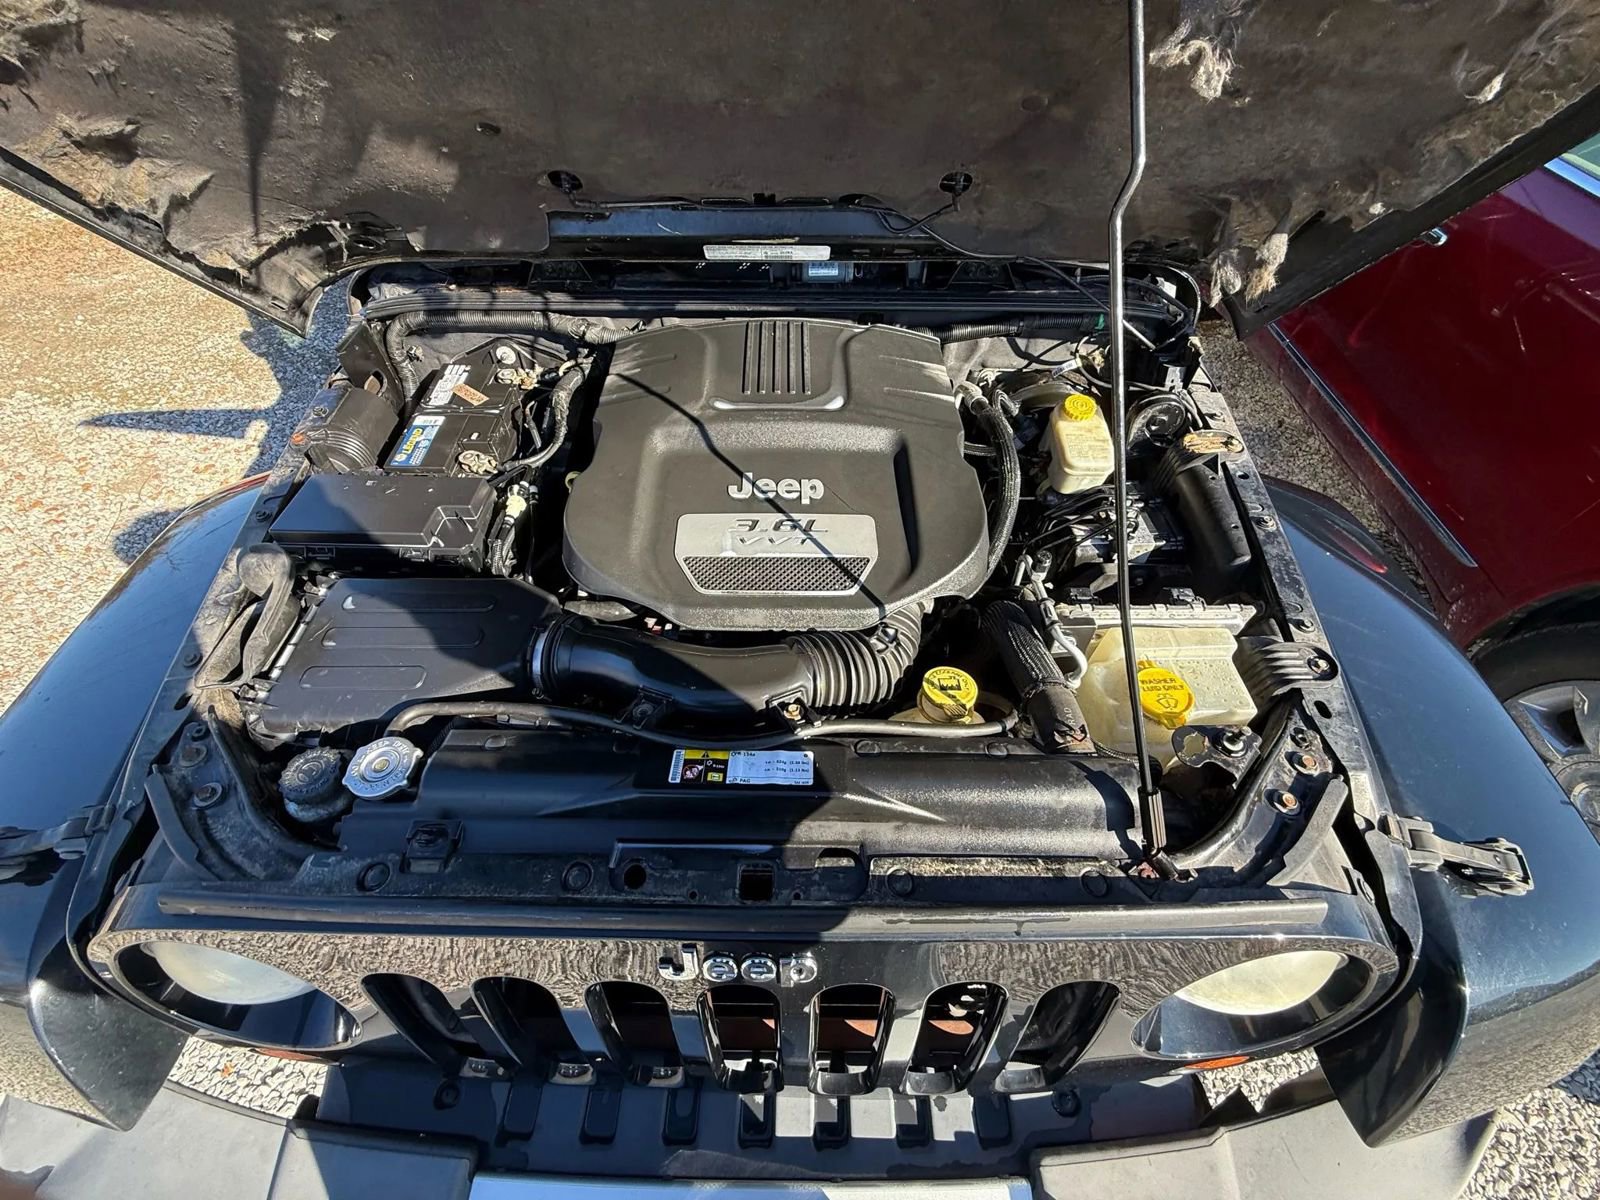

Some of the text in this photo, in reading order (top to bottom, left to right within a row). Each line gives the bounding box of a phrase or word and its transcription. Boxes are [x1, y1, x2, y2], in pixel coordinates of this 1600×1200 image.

[727, 472, 825, 505] Jeep
[727, 518, 829, 533] 3.6L
[1063, 707, 1077, 726] RAD
[658, 942, 818, 988] Jeep
